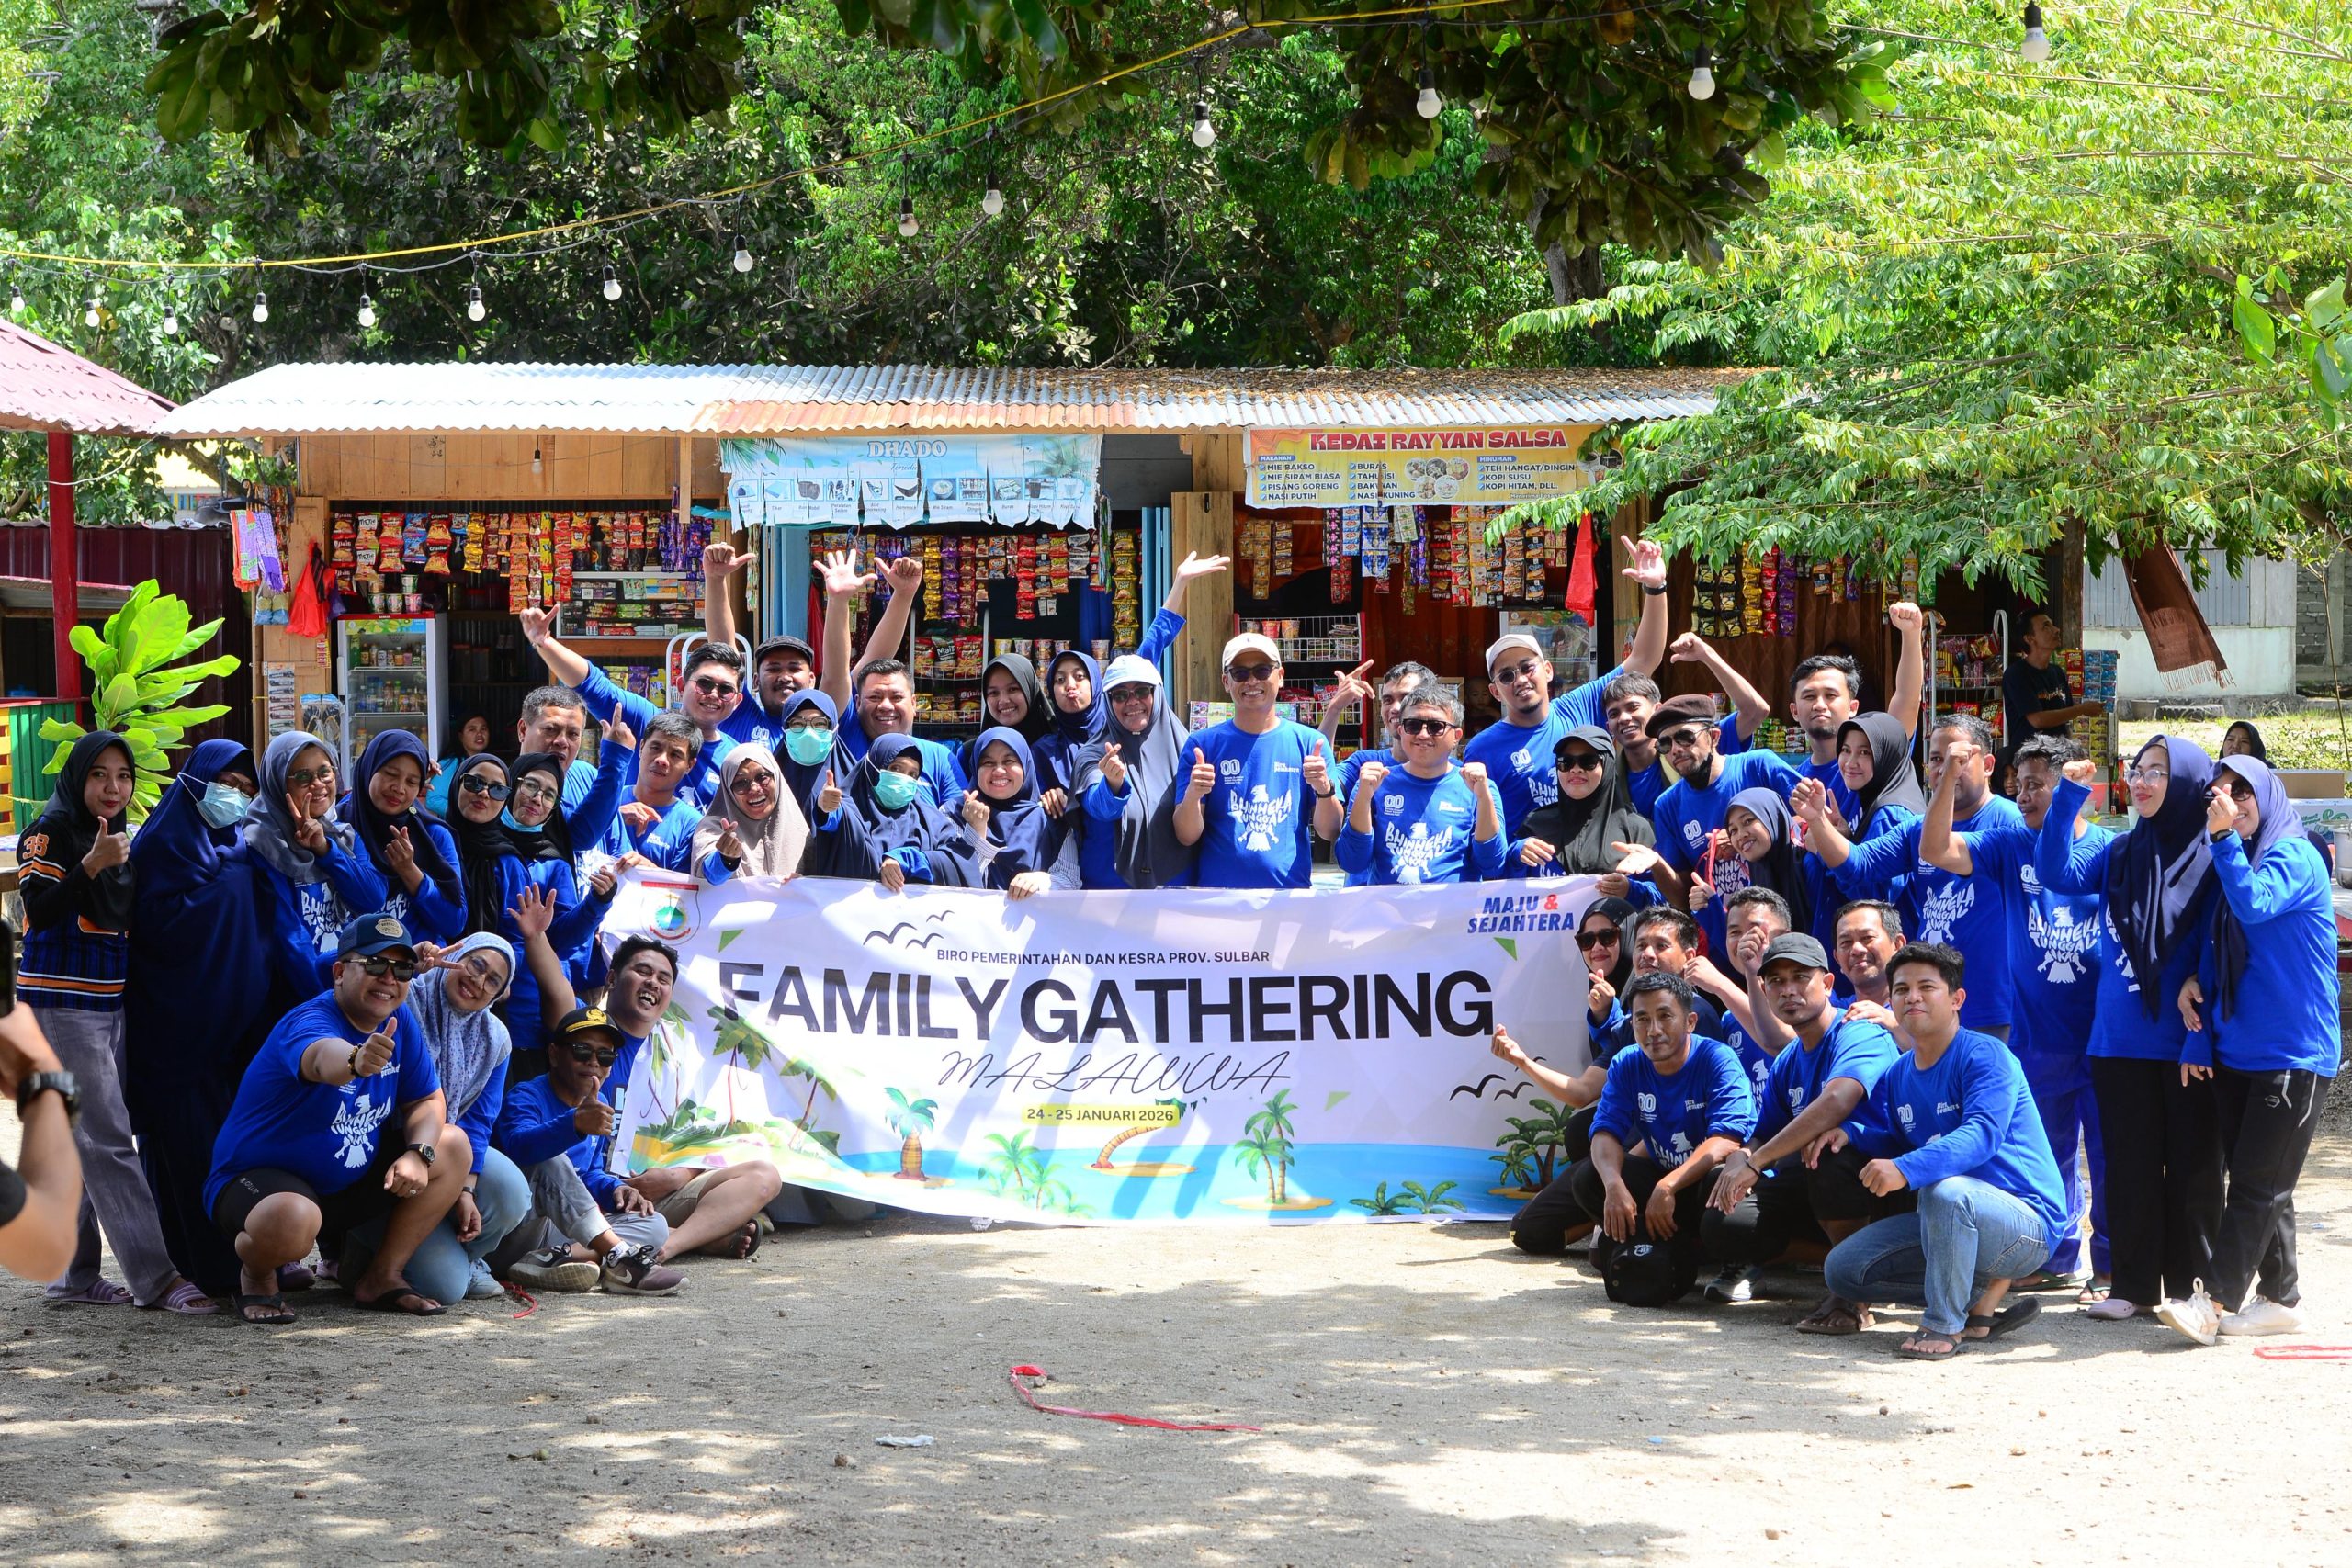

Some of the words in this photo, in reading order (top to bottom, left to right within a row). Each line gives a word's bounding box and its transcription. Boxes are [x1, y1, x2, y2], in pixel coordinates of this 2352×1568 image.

[867, 440, 947, 457] DHADO
[1310, 433, 1386, 451] KEDAI
[1391, 432, 1484, 451] RAYYAN
[1488, 430, 1567, 449] SALSA
[23, 833, 50, 860] 38
[1482, 896, 1539, 914] MAJU
[1544, 894, 1558, 910] &
[1467, 913, 1574, 933] SEJAHTERA
[2029, 931, 2098, 953] TUNGGAL
[937, 949, 968, 962] BIRO
[971, 951, 1081, 964] PEMERINTAHAN
[1085, 953, 1114, 964] DAN
[1119, 953, 1166, 964] KESRA
[1169, 952, 1210, 964] PROV.
[1214, 951, 1270, 962] SULBAR
[719, 962, 1010, 1041] FAMILY
[1020, 970, 1495, 1043] GATHERING
[937, 1050, 1291, 1095] MALAWWA
[1027, 1108, 1045, 1120] 24
[1056, 1109, 1073, 1120] 25
[1076, 1110, 1135, 1121] JANUARI
[1138, 1110, 1173, 1121] 2026
